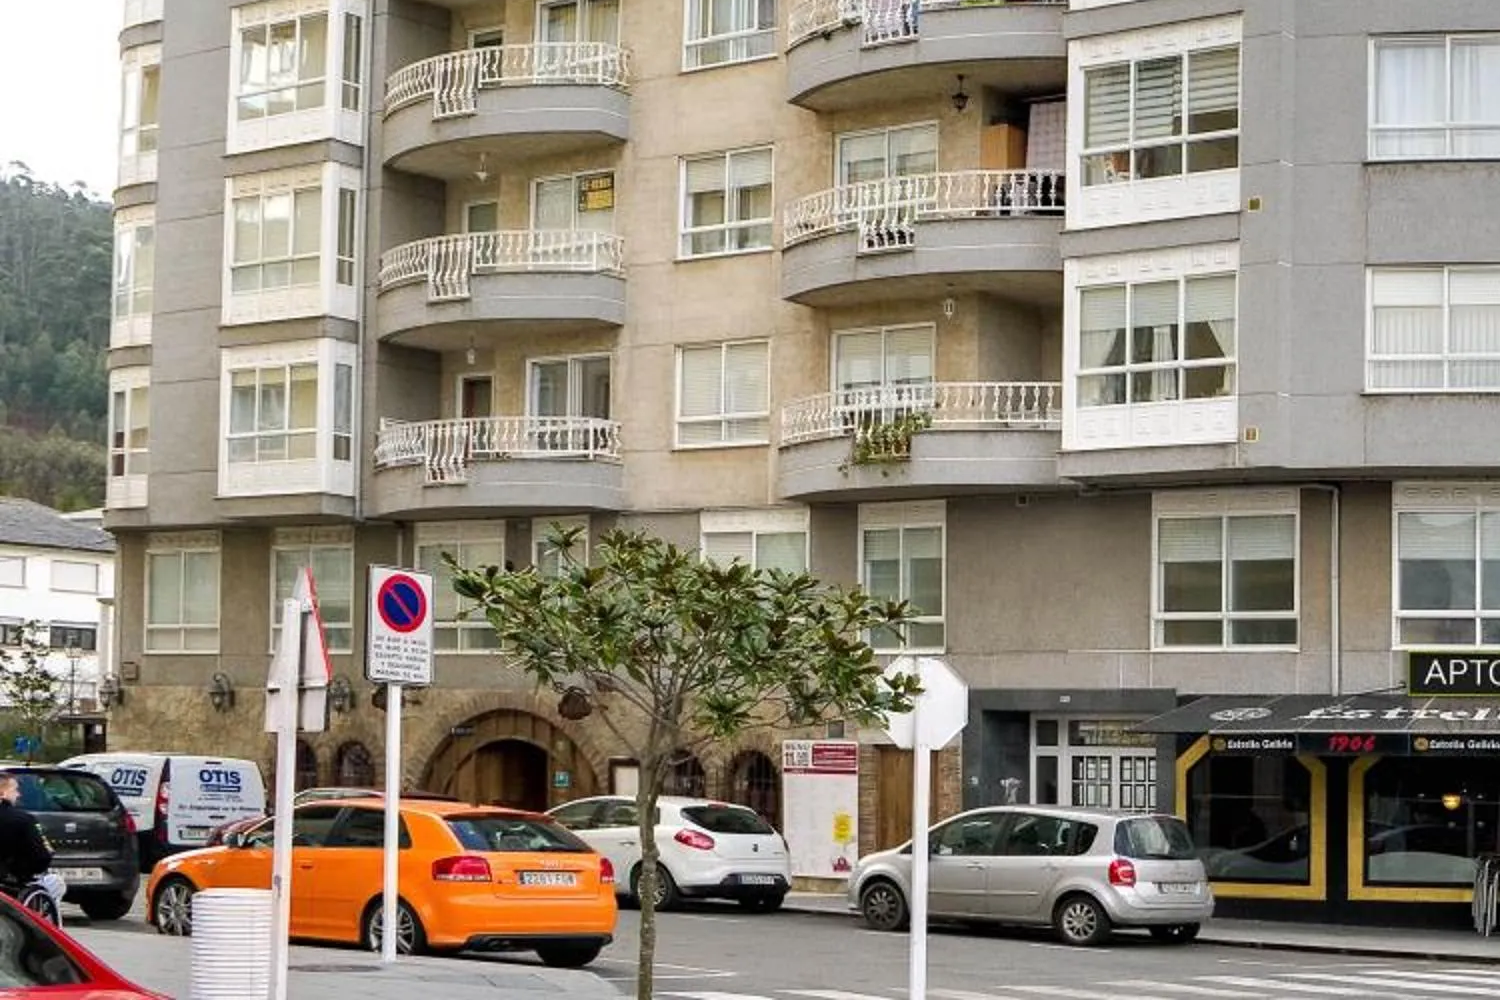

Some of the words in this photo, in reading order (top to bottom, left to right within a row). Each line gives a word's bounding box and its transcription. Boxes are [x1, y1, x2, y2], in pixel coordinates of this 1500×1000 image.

[1329, 735, 1377, 752] 1906
[111, 768, 148, 787] OTIS
[199, 769, 242, 785] OTIS
